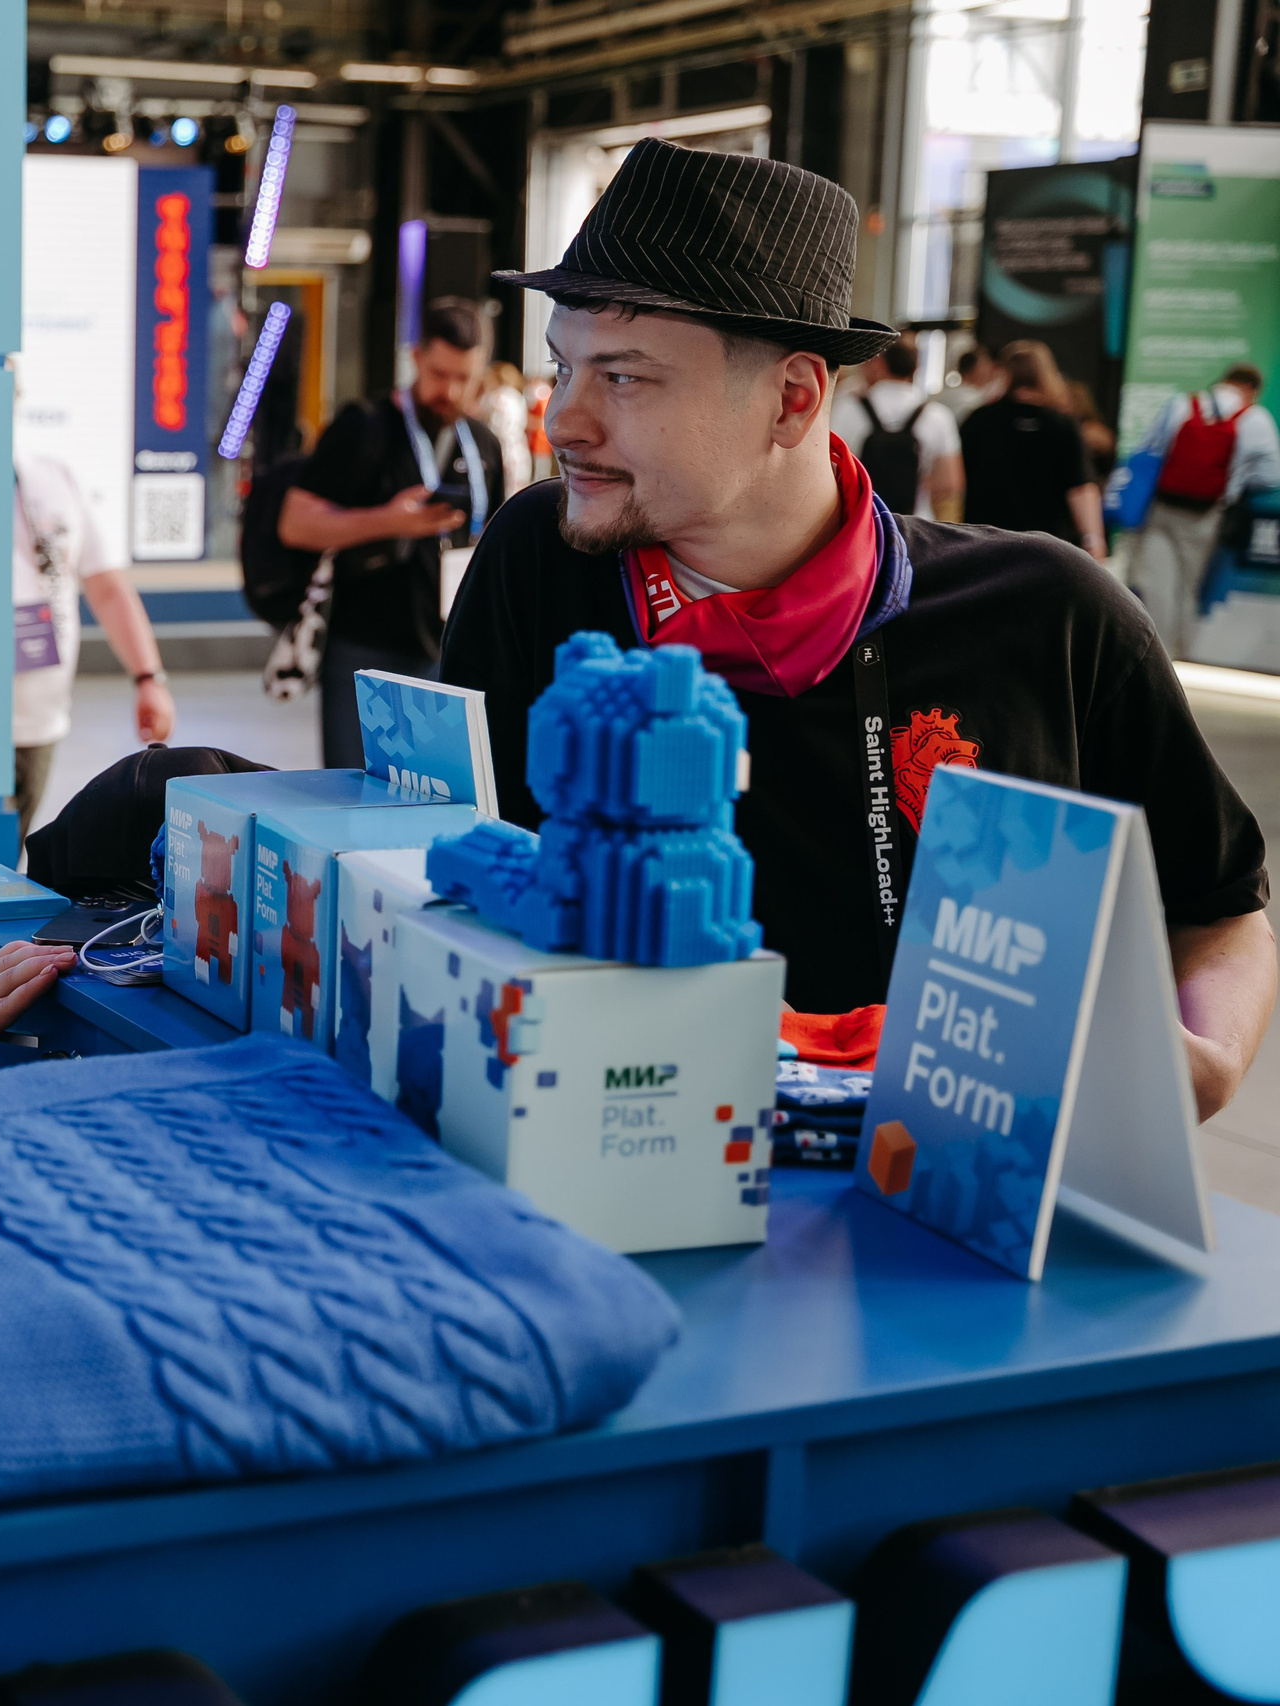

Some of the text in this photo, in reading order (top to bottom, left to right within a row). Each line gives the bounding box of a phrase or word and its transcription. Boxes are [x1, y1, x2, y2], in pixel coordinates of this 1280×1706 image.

[169, 807, 193, 830] МИР
[865, 716, 898, 926] Saint HighLoad++
[168, 834, 188, 858] Plat.
[257, 843, 279, 870] МИР
[168, 855, 191, 881] Form
[257, 873, 275, 900] Plat.
[256, 895, 278, 925] Form
[932, 897, 1047, 975] МИР
[916, 980, 1005, 1064] Plat.
[605, 1065, 678, 1090] МИР
[904, 1043, 1016, 1136] Form
[602, 1105, 666, 1130] Plat.
[600, 1133, 677, 1158] Form
